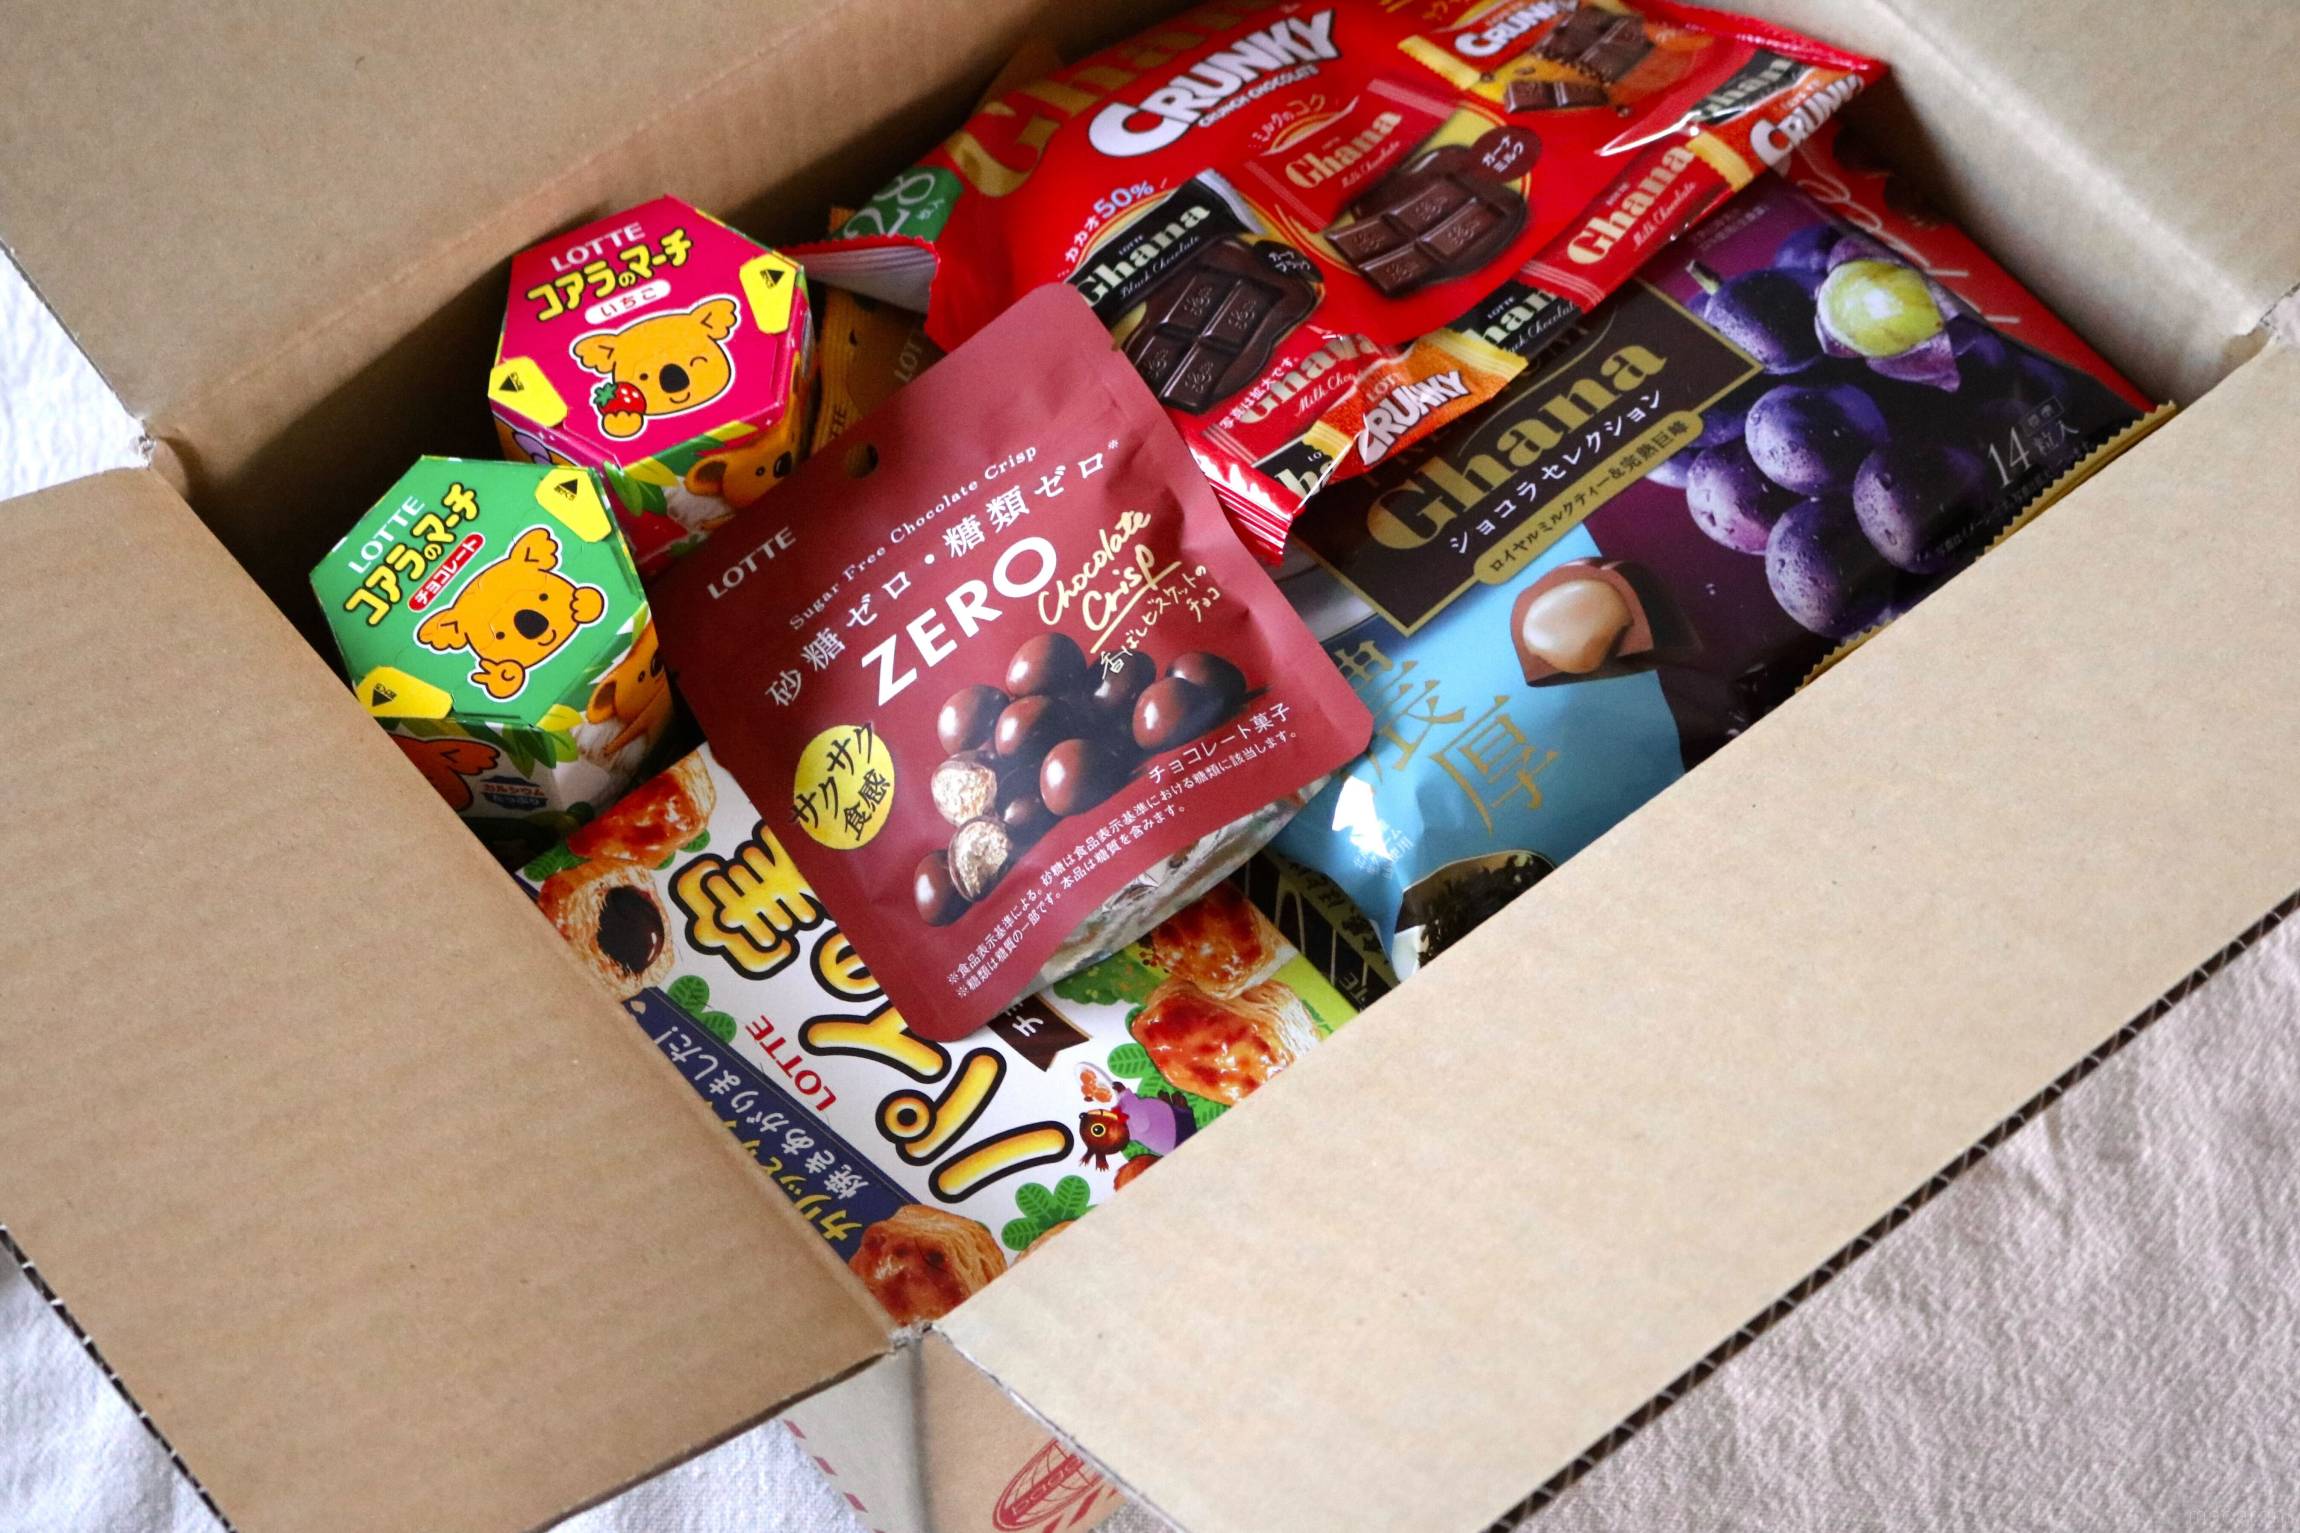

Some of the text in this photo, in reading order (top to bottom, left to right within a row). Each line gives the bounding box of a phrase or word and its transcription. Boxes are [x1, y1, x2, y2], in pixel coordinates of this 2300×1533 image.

[1088, 8, 1341, 157] CRUNKY
[1285, 111, 1404, 189] Ghana
[1492, 140, 1525, 174] ミルク
[551, 222, 646, 273] LOTTE
[1567, 146, 1696, 265] Ghana
[1632, 181, 1698, 251] Milk Chocolate
[525, 228, 693, 322] コアラのマーチ
[1077, 206, 1212, 308] Ghana
[1295, 387, 1328, 418] Milk
[1367, 345, 1668, 549] Ghana
[1449, 389, 1661, 555] ショコラセレクション
[343, 482, 480, 627] コアラのマーチ
[349, 495, 425, 574] LOTTE
[416, 537, 481, 607] チョコレート
[707, 526, 798, 601] LOTTE
[789, 445, 1038, 632] Sugar Free Chocolate Crisp
[1037, 509, 1152, 626] Chocolate
[861, 535, 1058, 707] ZERO
[1081, 543, 1157, 632] Crisp
[790, 720, 878, 831] サクサク
[1148, 701, 1292, 785] チョコレート菓子
[842, 766, 893, 844] 食感
[745, 1014, 838, 1113] LOTTE
